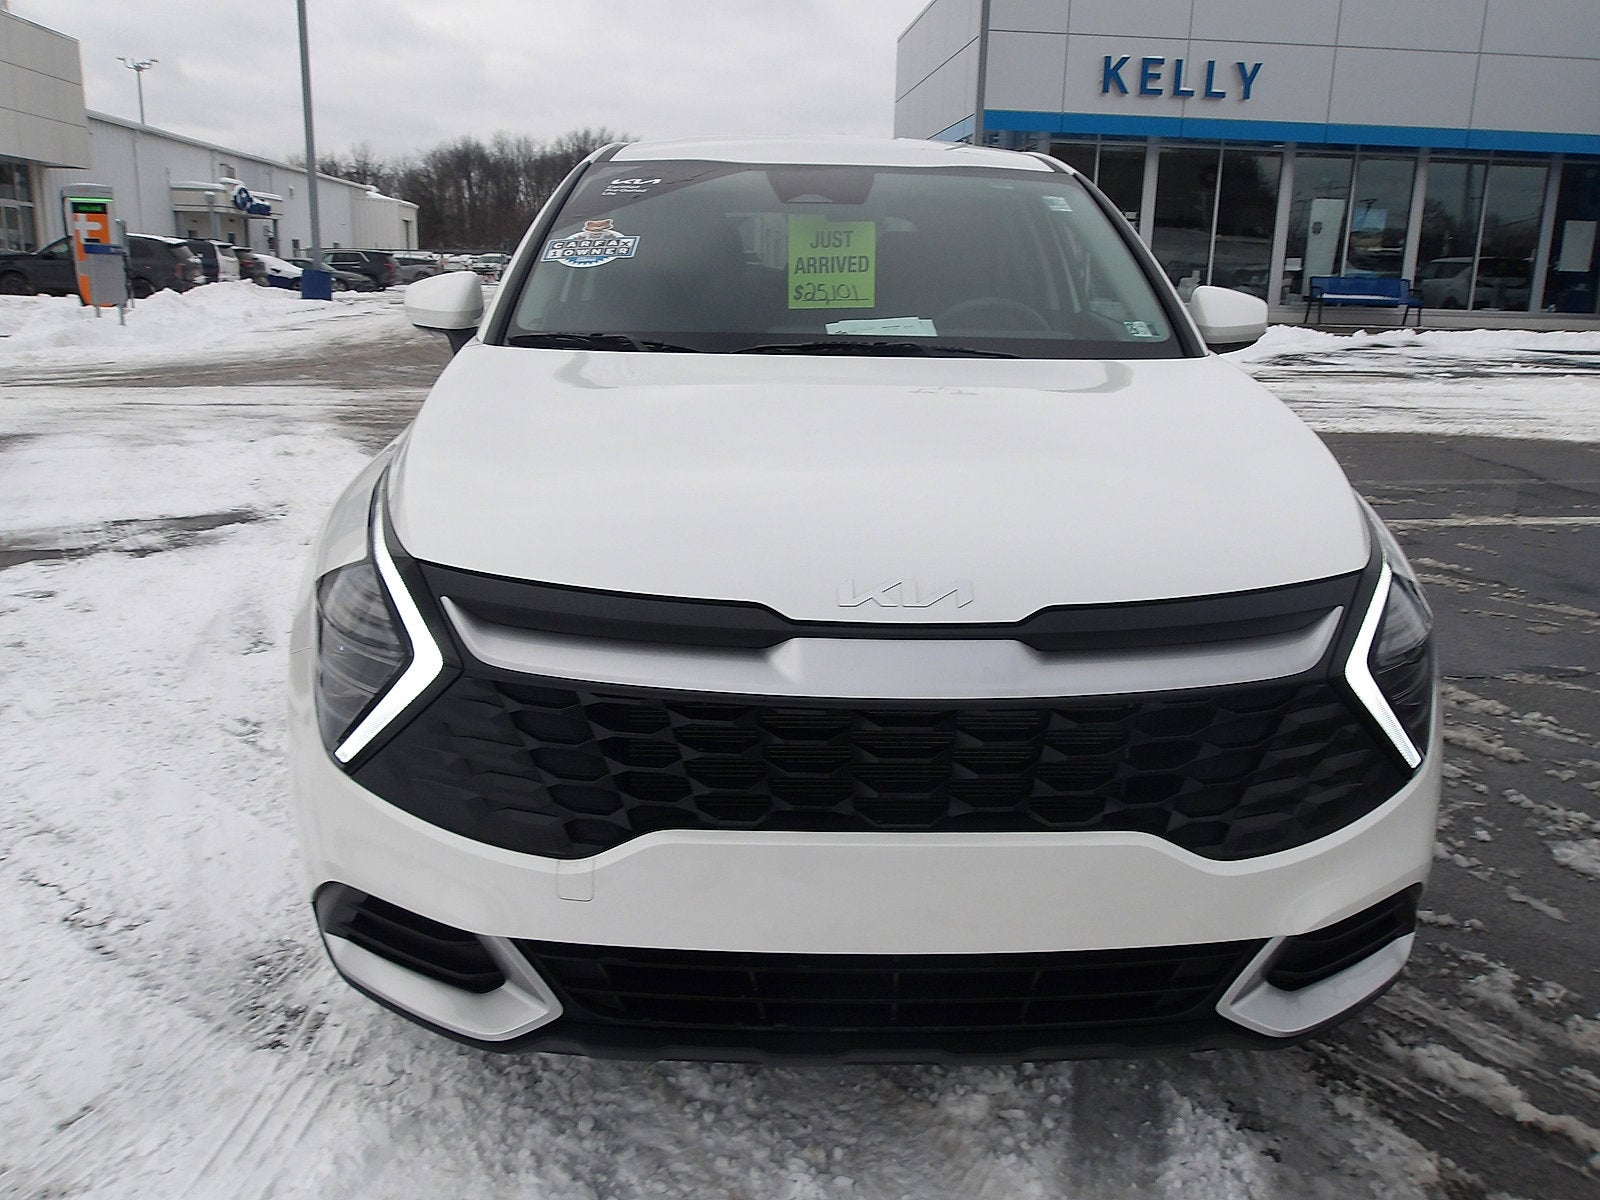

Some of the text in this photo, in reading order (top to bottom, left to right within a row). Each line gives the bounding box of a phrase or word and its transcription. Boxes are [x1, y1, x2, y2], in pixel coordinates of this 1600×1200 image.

[1102, 54, 1263, 100] KELLY
[552, 239, 632, 249] CARFAX
[810, 230, 854, 249] JUST
[794, 255, 869, 274] ARRIVED
[793, 282, 859, 304] $25,101
[837, 578, 974, 608] KIA
